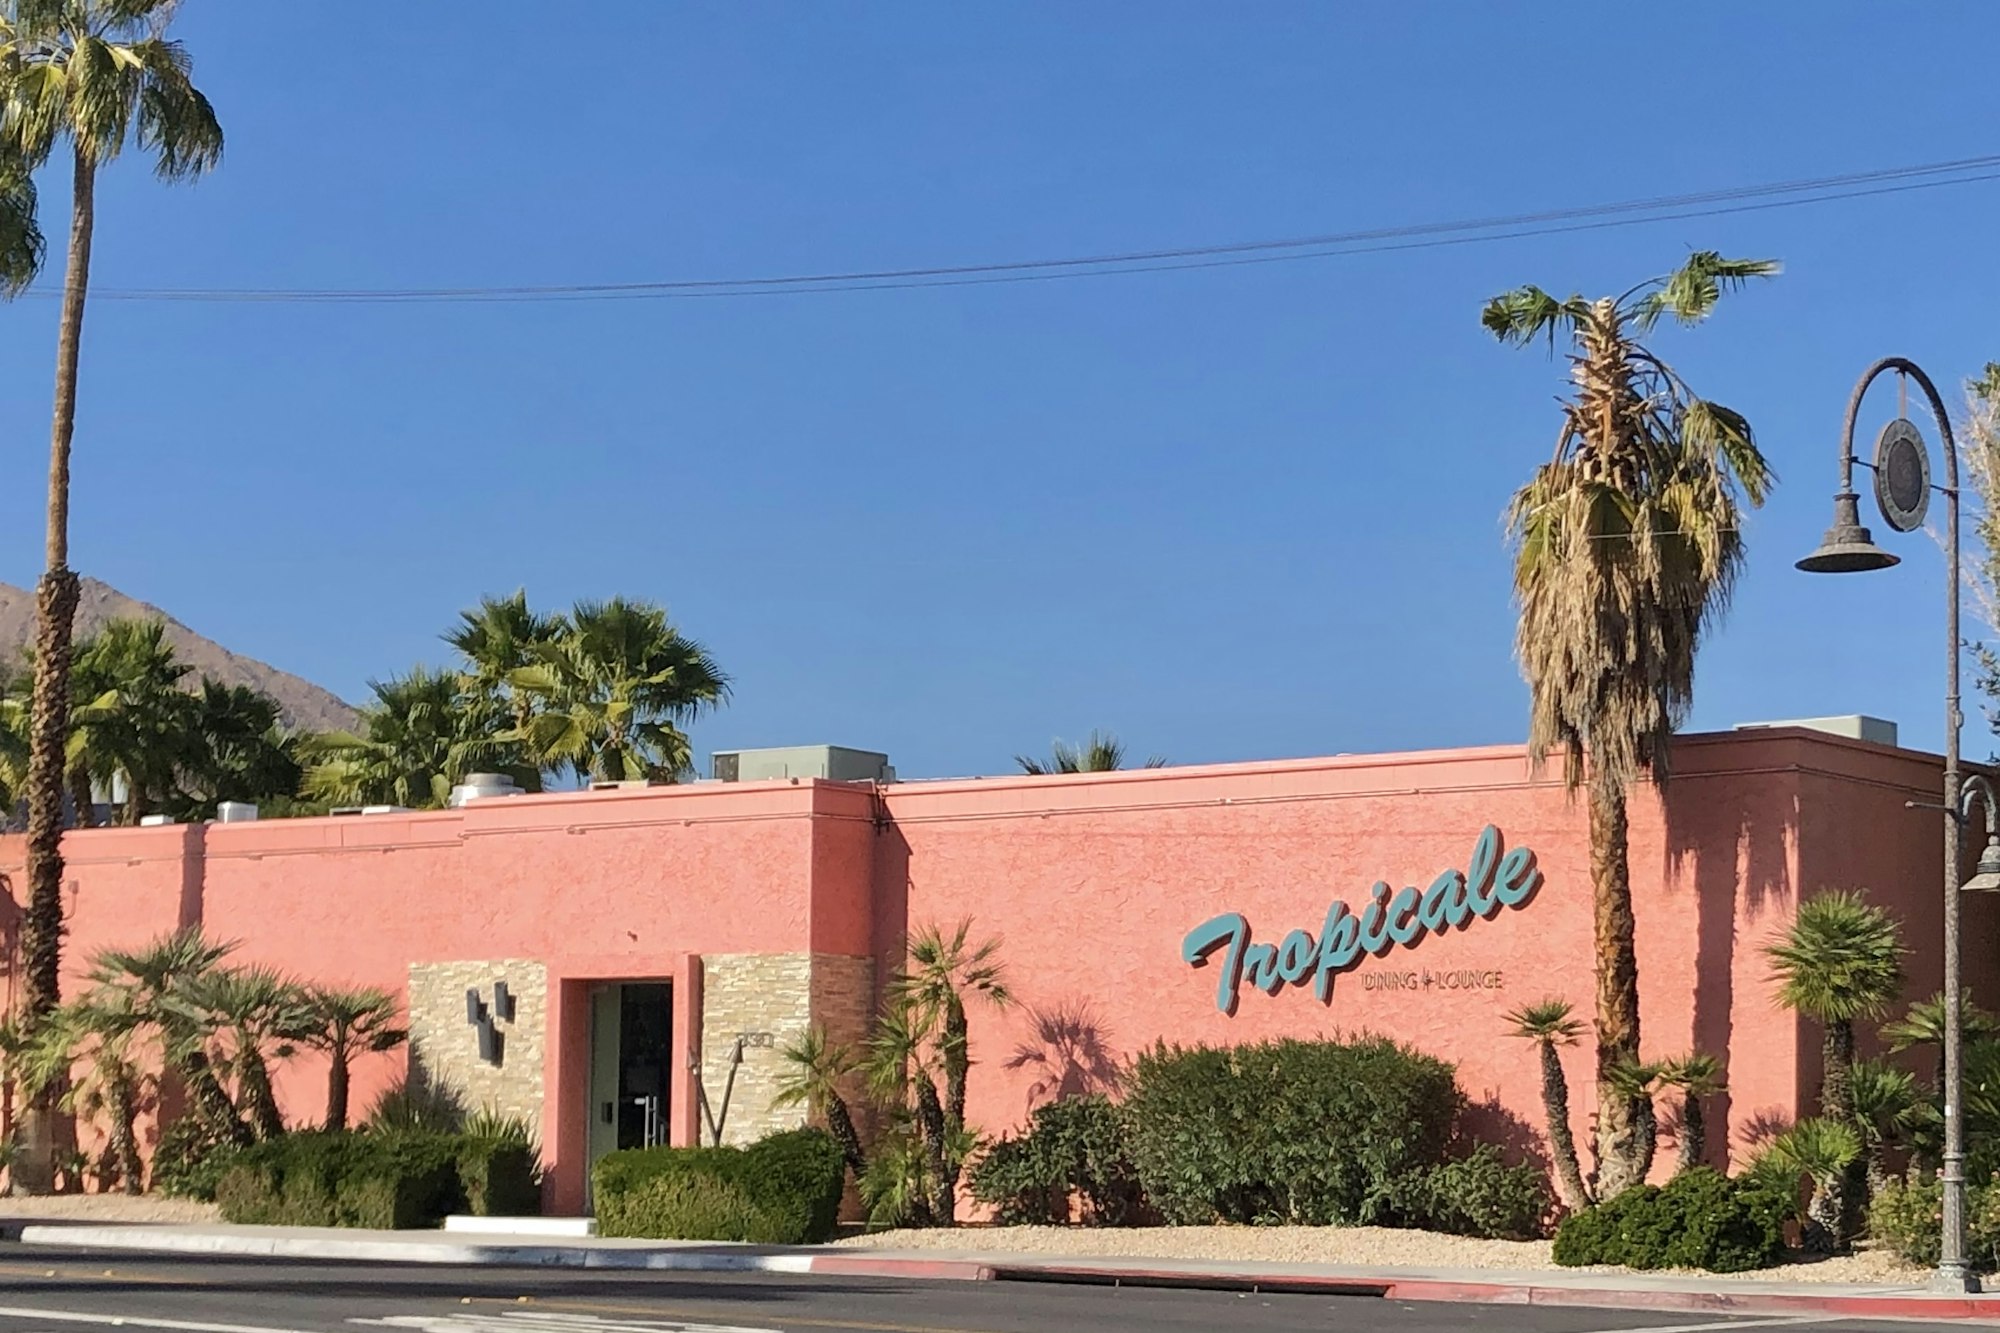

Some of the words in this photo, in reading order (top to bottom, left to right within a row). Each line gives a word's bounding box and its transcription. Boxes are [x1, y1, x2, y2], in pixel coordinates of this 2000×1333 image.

[1182, 823, 1540, 1014] Tropicale
[1360, 971, 1418, 991] DINING
[1435, 970, 1504, 990] LOUNGE
